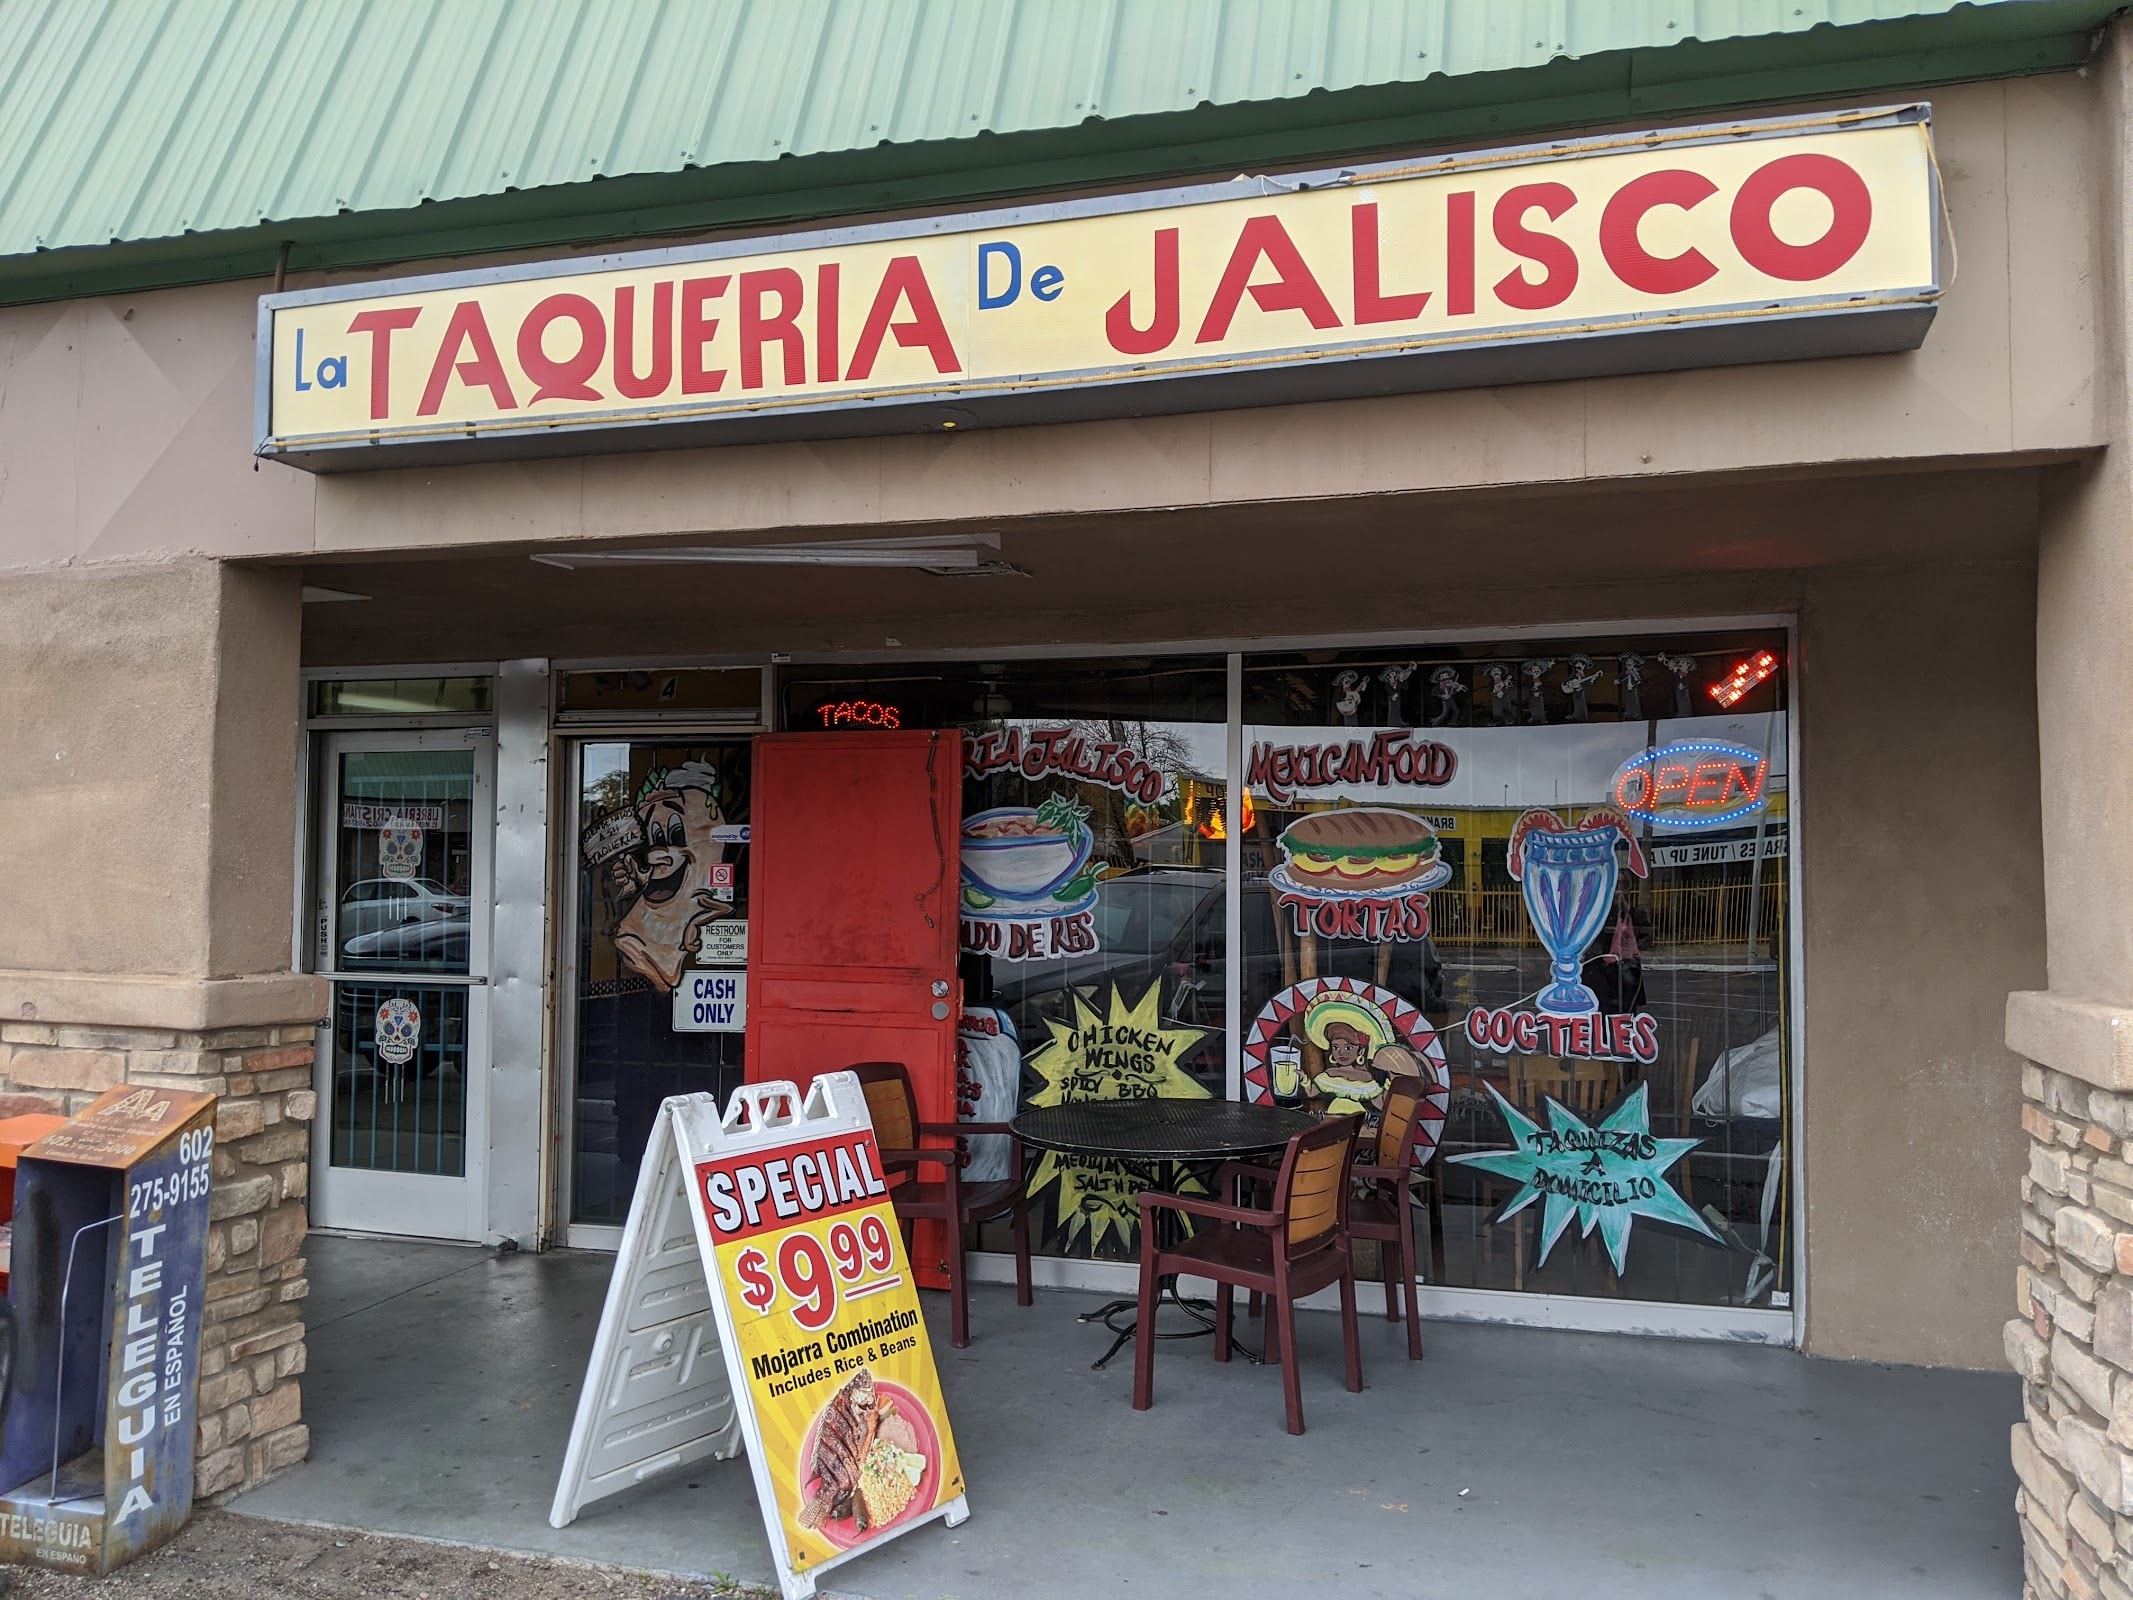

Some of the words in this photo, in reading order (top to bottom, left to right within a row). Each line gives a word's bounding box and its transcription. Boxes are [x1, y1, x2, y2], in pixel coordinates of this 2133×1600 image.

[295, 327, 348, 392] La
[347, 255, 963, 420] TAQUERIA
[978, 241, 1064, 311] De
[1105, 153, 1872, 355] JALISCO
[661, 677, 676, 699] 4
[817, 700, 900, 729] TACOS
[963, 727, 1021, 775] RIA
[1616, 760, 1767, 811] OPEN
[320, 918, 328, 944] PUSH
[705, 925, 746, 936] RESTROOM
[960, 919, 1000, 952] LDO
[1009, 923, 1043, 958] DE
[1050, 914, 1095, 953] RES
[1279, 893, 1429, 942] TORTAS
[694, 978, 736, 999] CASH
[693, 1003, 735, 1024] ONLY
[1067, 1024, 1176, 1056] CHICKEN
[1085, 1048, 1155, 1073] WINGS
[1060, 1076, 1103, 1093] SPICY
[1117, 1082, 1157, 1099] BBQ
[180, 1125, 214, 1166] 602
[1527, 1128, 1657, 1160] TAQUIZAS
[1580, 1151, 1606, 1176] A
[130, 1162, 211, 1220] 275-9155
[705, 1141, 886, 1232] SPECIAL
[1531, 1166, 1656, 1206] DOMICILIO
[164, 1284, 189, 1389] ESPAÑOL
[751, 1341, 823, 1382] Mojarra
[826, 1308, 919, 1356] Combination
[112, 1224, 167, 1527] TELEGUIA
[768, 1364, 831, 1398] Includes
[834, 1354, 864, 1375] Rice
[867, 1347, 879, 1363] &
[880, 1334, 917, 1359] Beans
[163, 1391, 182, 1428] EN
[0, 1512, 92, 1549] TELEGUIA
[36, 1548, 49, 1559] EN
